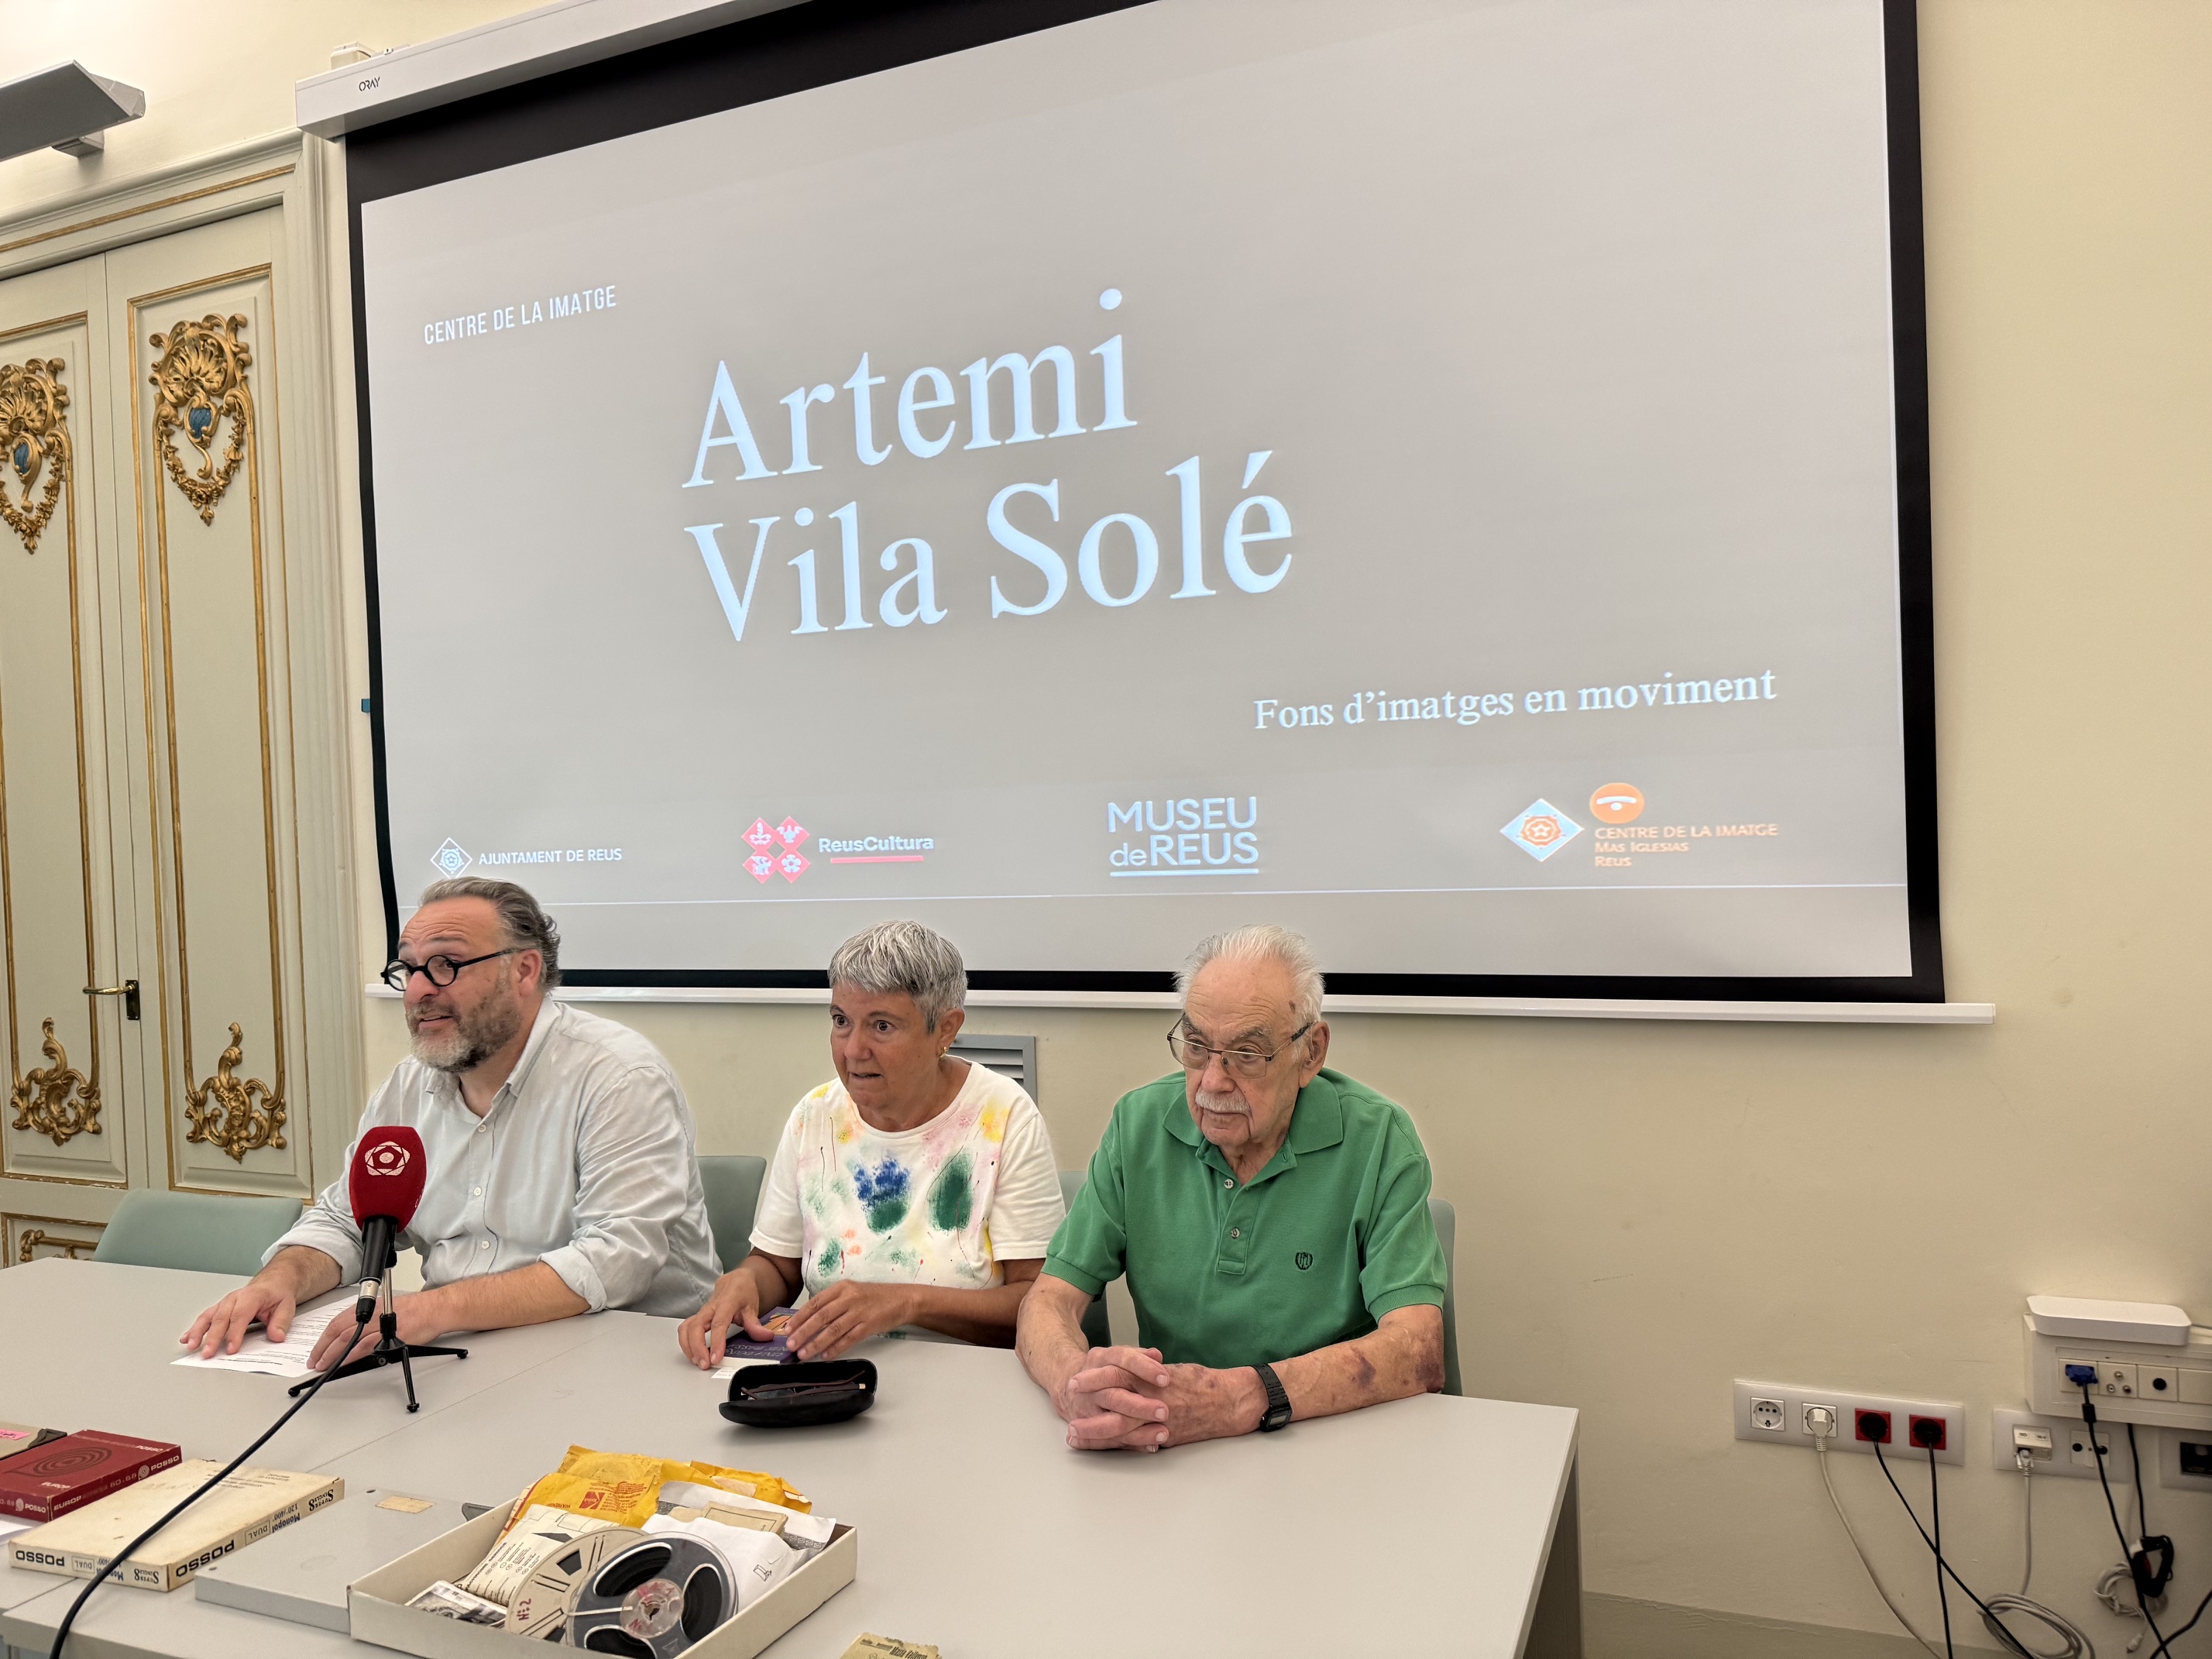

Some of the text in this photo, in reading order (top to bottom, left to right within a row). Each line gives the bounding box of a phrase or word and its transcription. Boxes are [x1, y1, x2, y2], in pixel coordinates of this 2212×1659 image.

[359, 77, 380, 91] ORAY
[424, 285, 617, 345] CENTRE DE LA IMATGE
[682, 288, 1137, 487] Artemi
[685, 450, 1292, 641] Vila Solé
[1254, 699, 1334, 730] Fons
[1523, 689, 1567, 714] en
[1577, 670, 1778, 713] moviment
[1107, 796, 1258, 833] MUSEU
[1595, 823, 1779, 839] CENTRE DE LA IMATGE
[479, 847, 623, 865] AJUNTAMENT DE REUS
[818, 835, 935, 854] ReusCultura
[53, 1495, 82, 1511] EUROP
[150, 1455, 180, 1472] POSSO
[15, 1550, 65, 1567] POSSO
[175, 1513, 301, 1578] Monopol DUAL POSSO
[75, 1559, 92, 1570] DUAL
